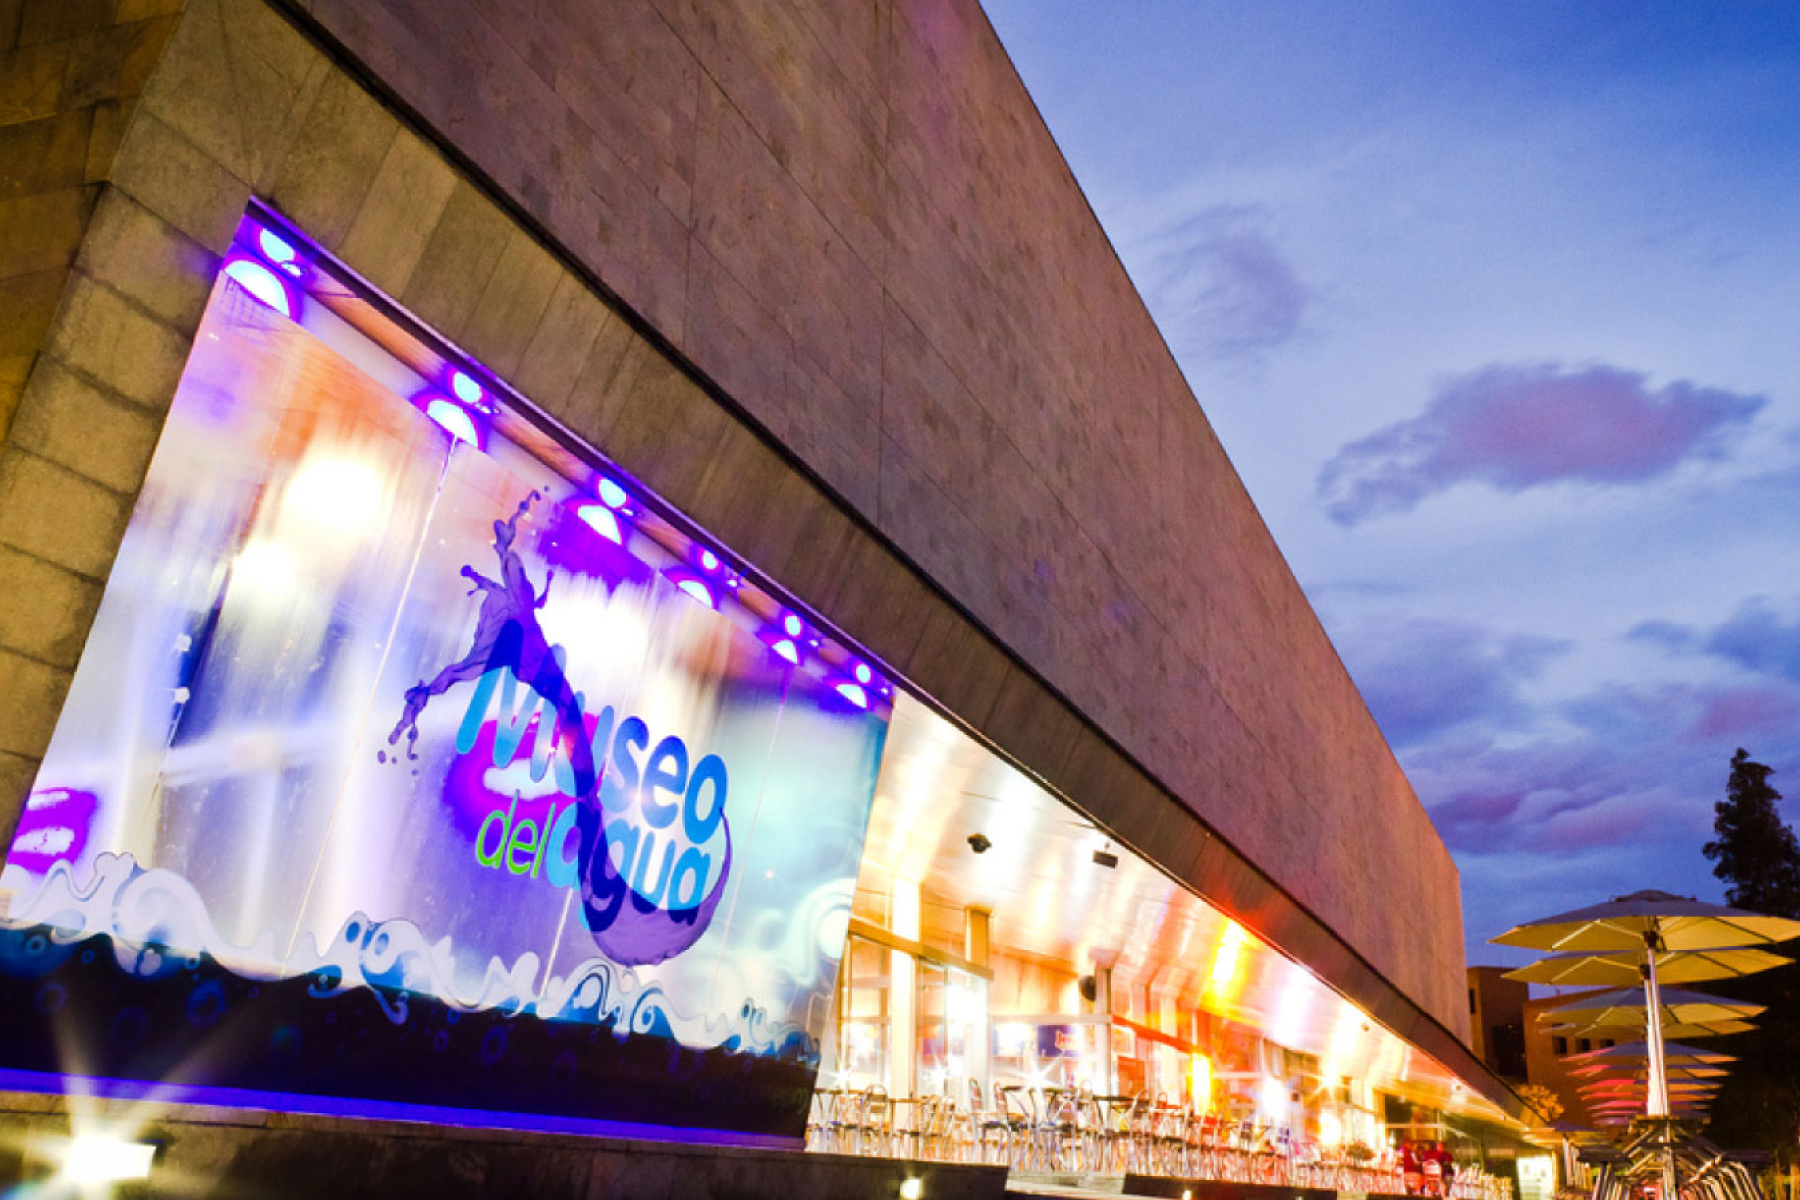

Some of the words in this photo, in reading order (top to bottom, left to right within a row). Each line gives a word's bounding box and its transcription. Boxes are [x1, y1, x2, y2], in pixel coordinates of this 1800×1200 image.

[456, 619, 728, 844] Museo
[475, 788, 556, 880] del
[546, 801, 711, 932] agua
